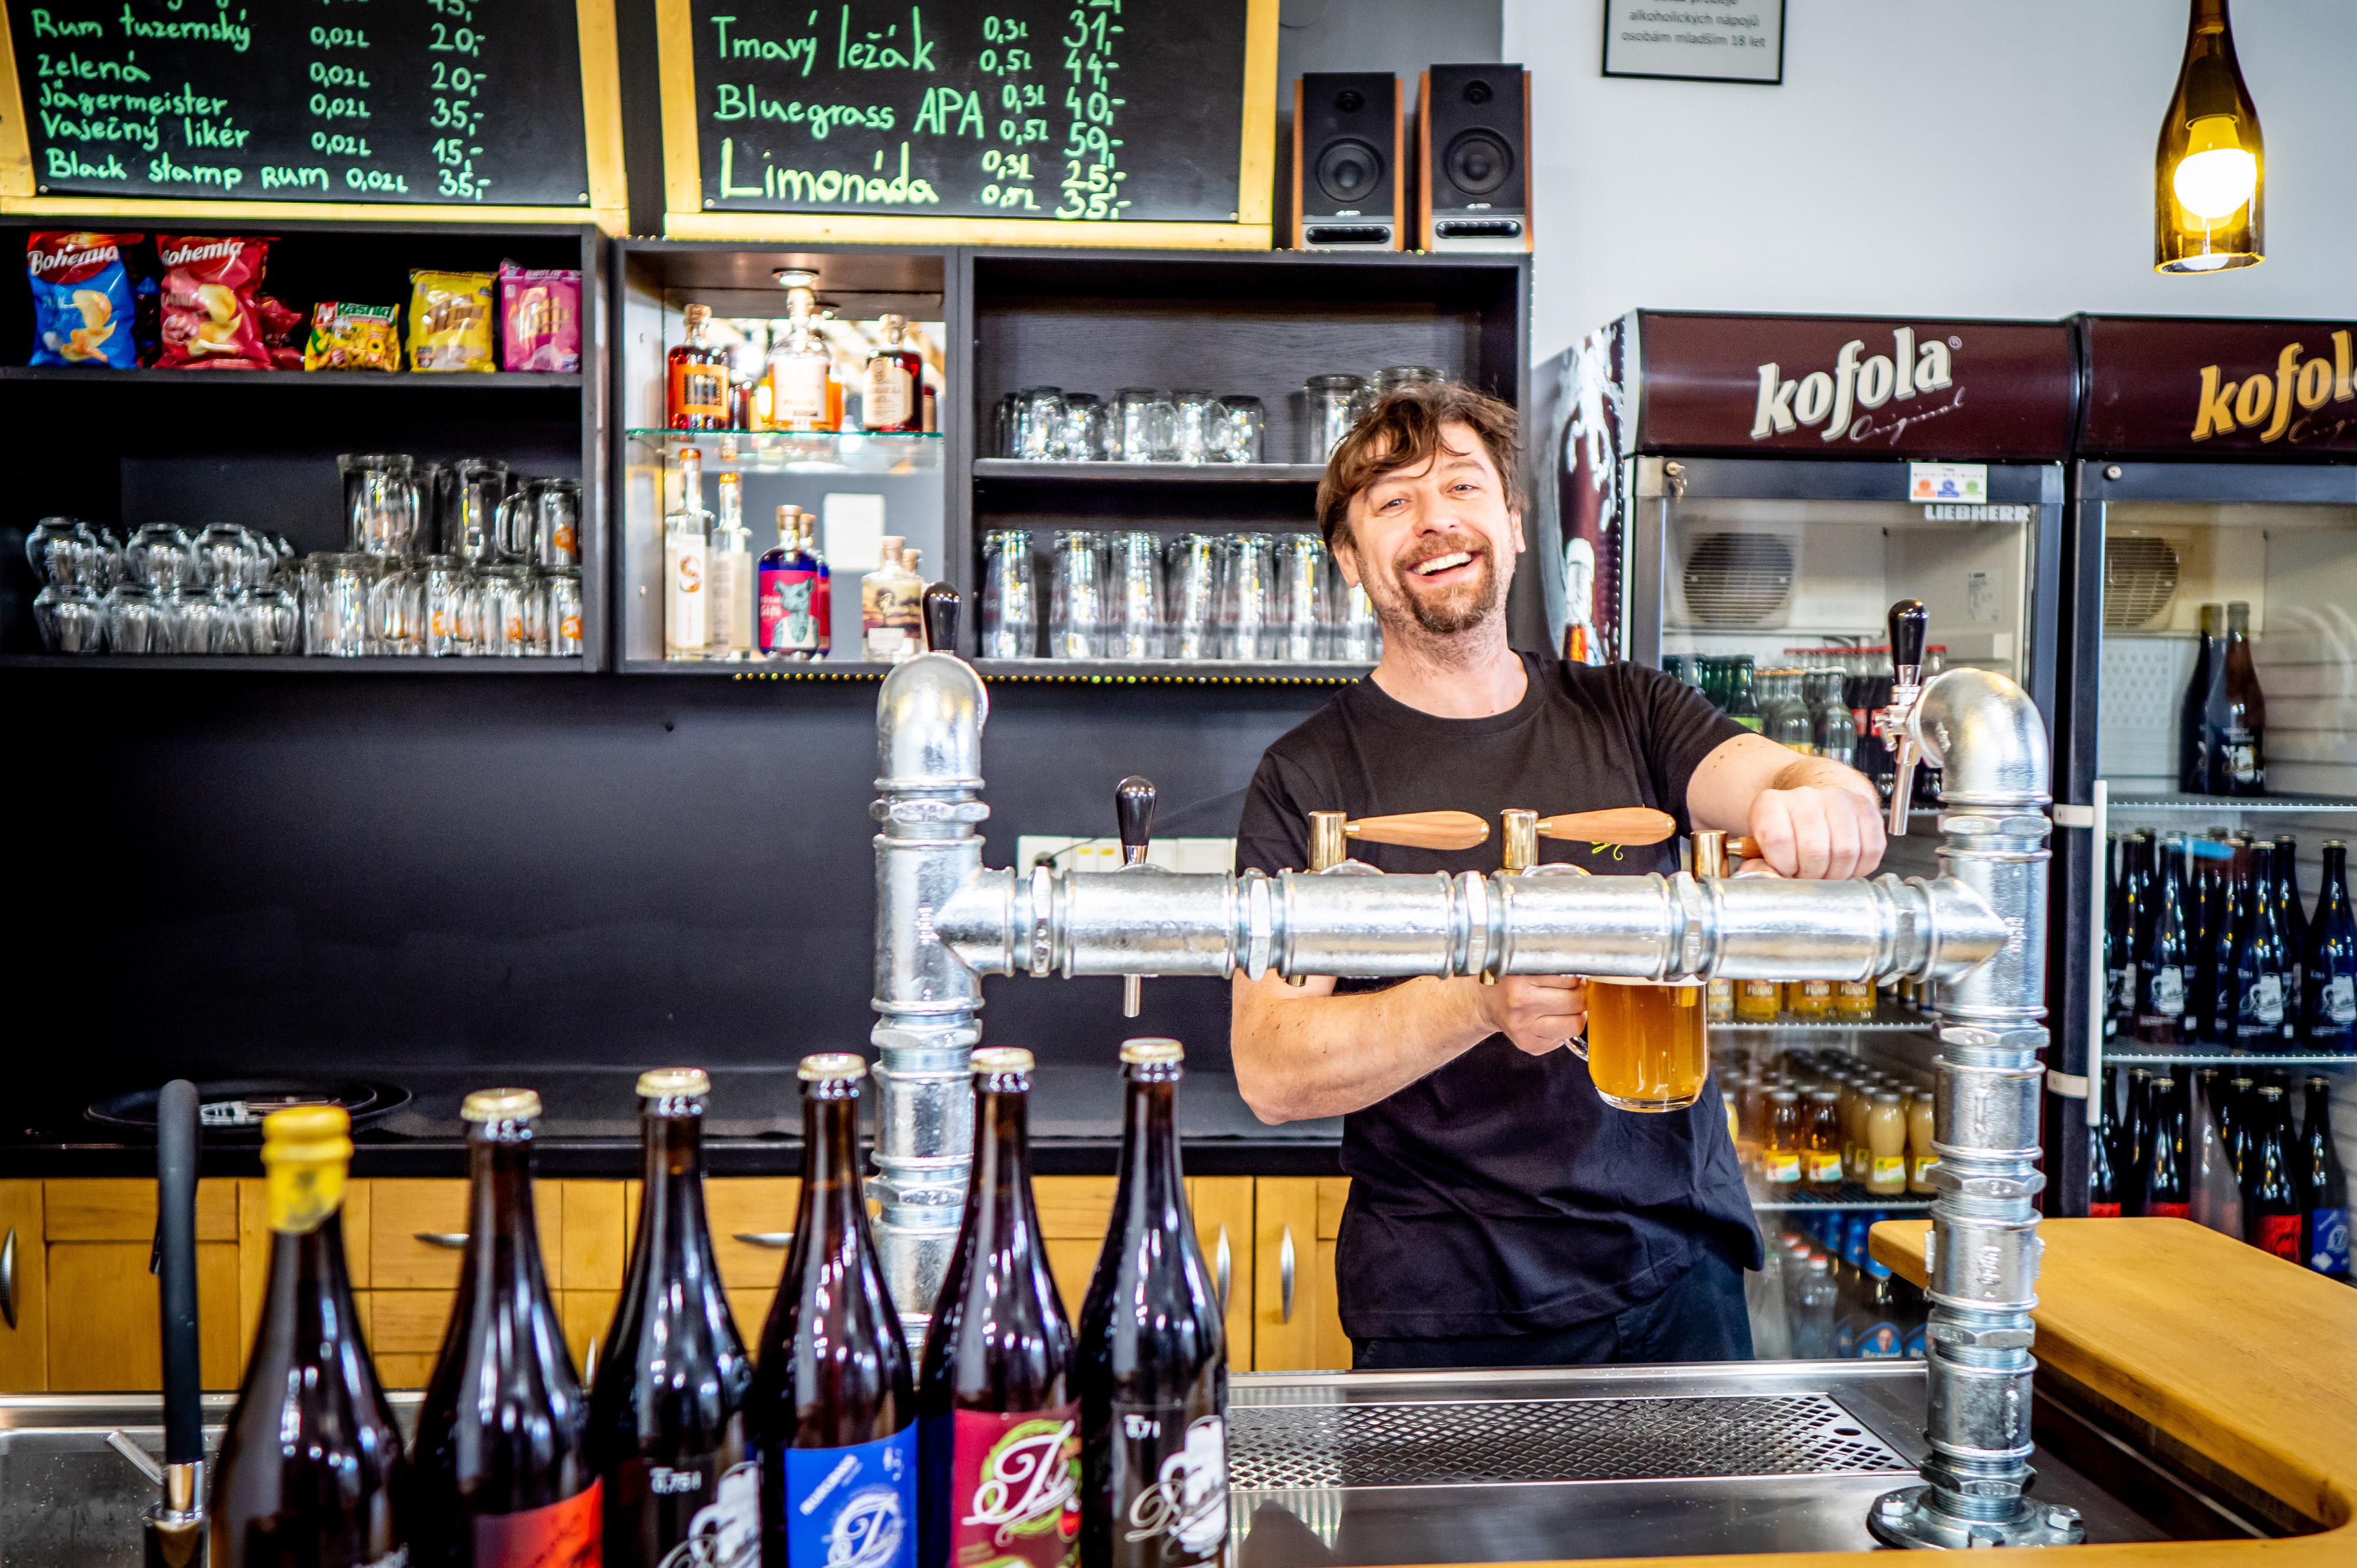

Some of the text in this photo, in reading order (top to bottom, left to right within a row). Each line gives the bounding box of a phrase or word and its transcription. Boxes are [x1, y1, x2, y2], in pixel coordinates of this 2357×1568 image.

[31, 8, 103, 38] Rum
[119, 3, 250, 52] tuzemský
[710, 9, 818, 77] Tmavý
[837, 4, 936, 71] ležák
[37, 49, 151, 82] Zelená
[39, 78, 228, 116] Jägermeister
[713, 84, 896, 139] Bluegrass
[913, 87, 985, 139] APA
[39, 109, 160, 152] Vaječný
[184, 117, 250, 147] likér
[45, 147, 127, 181] Black
[719, 137, 940, 204] Limonáda
[28, 245, 120, 277] Bohemia
[2191, 329, 2357, 443] kofol
[1924, 504, 2031, 521] LIEBHERR
